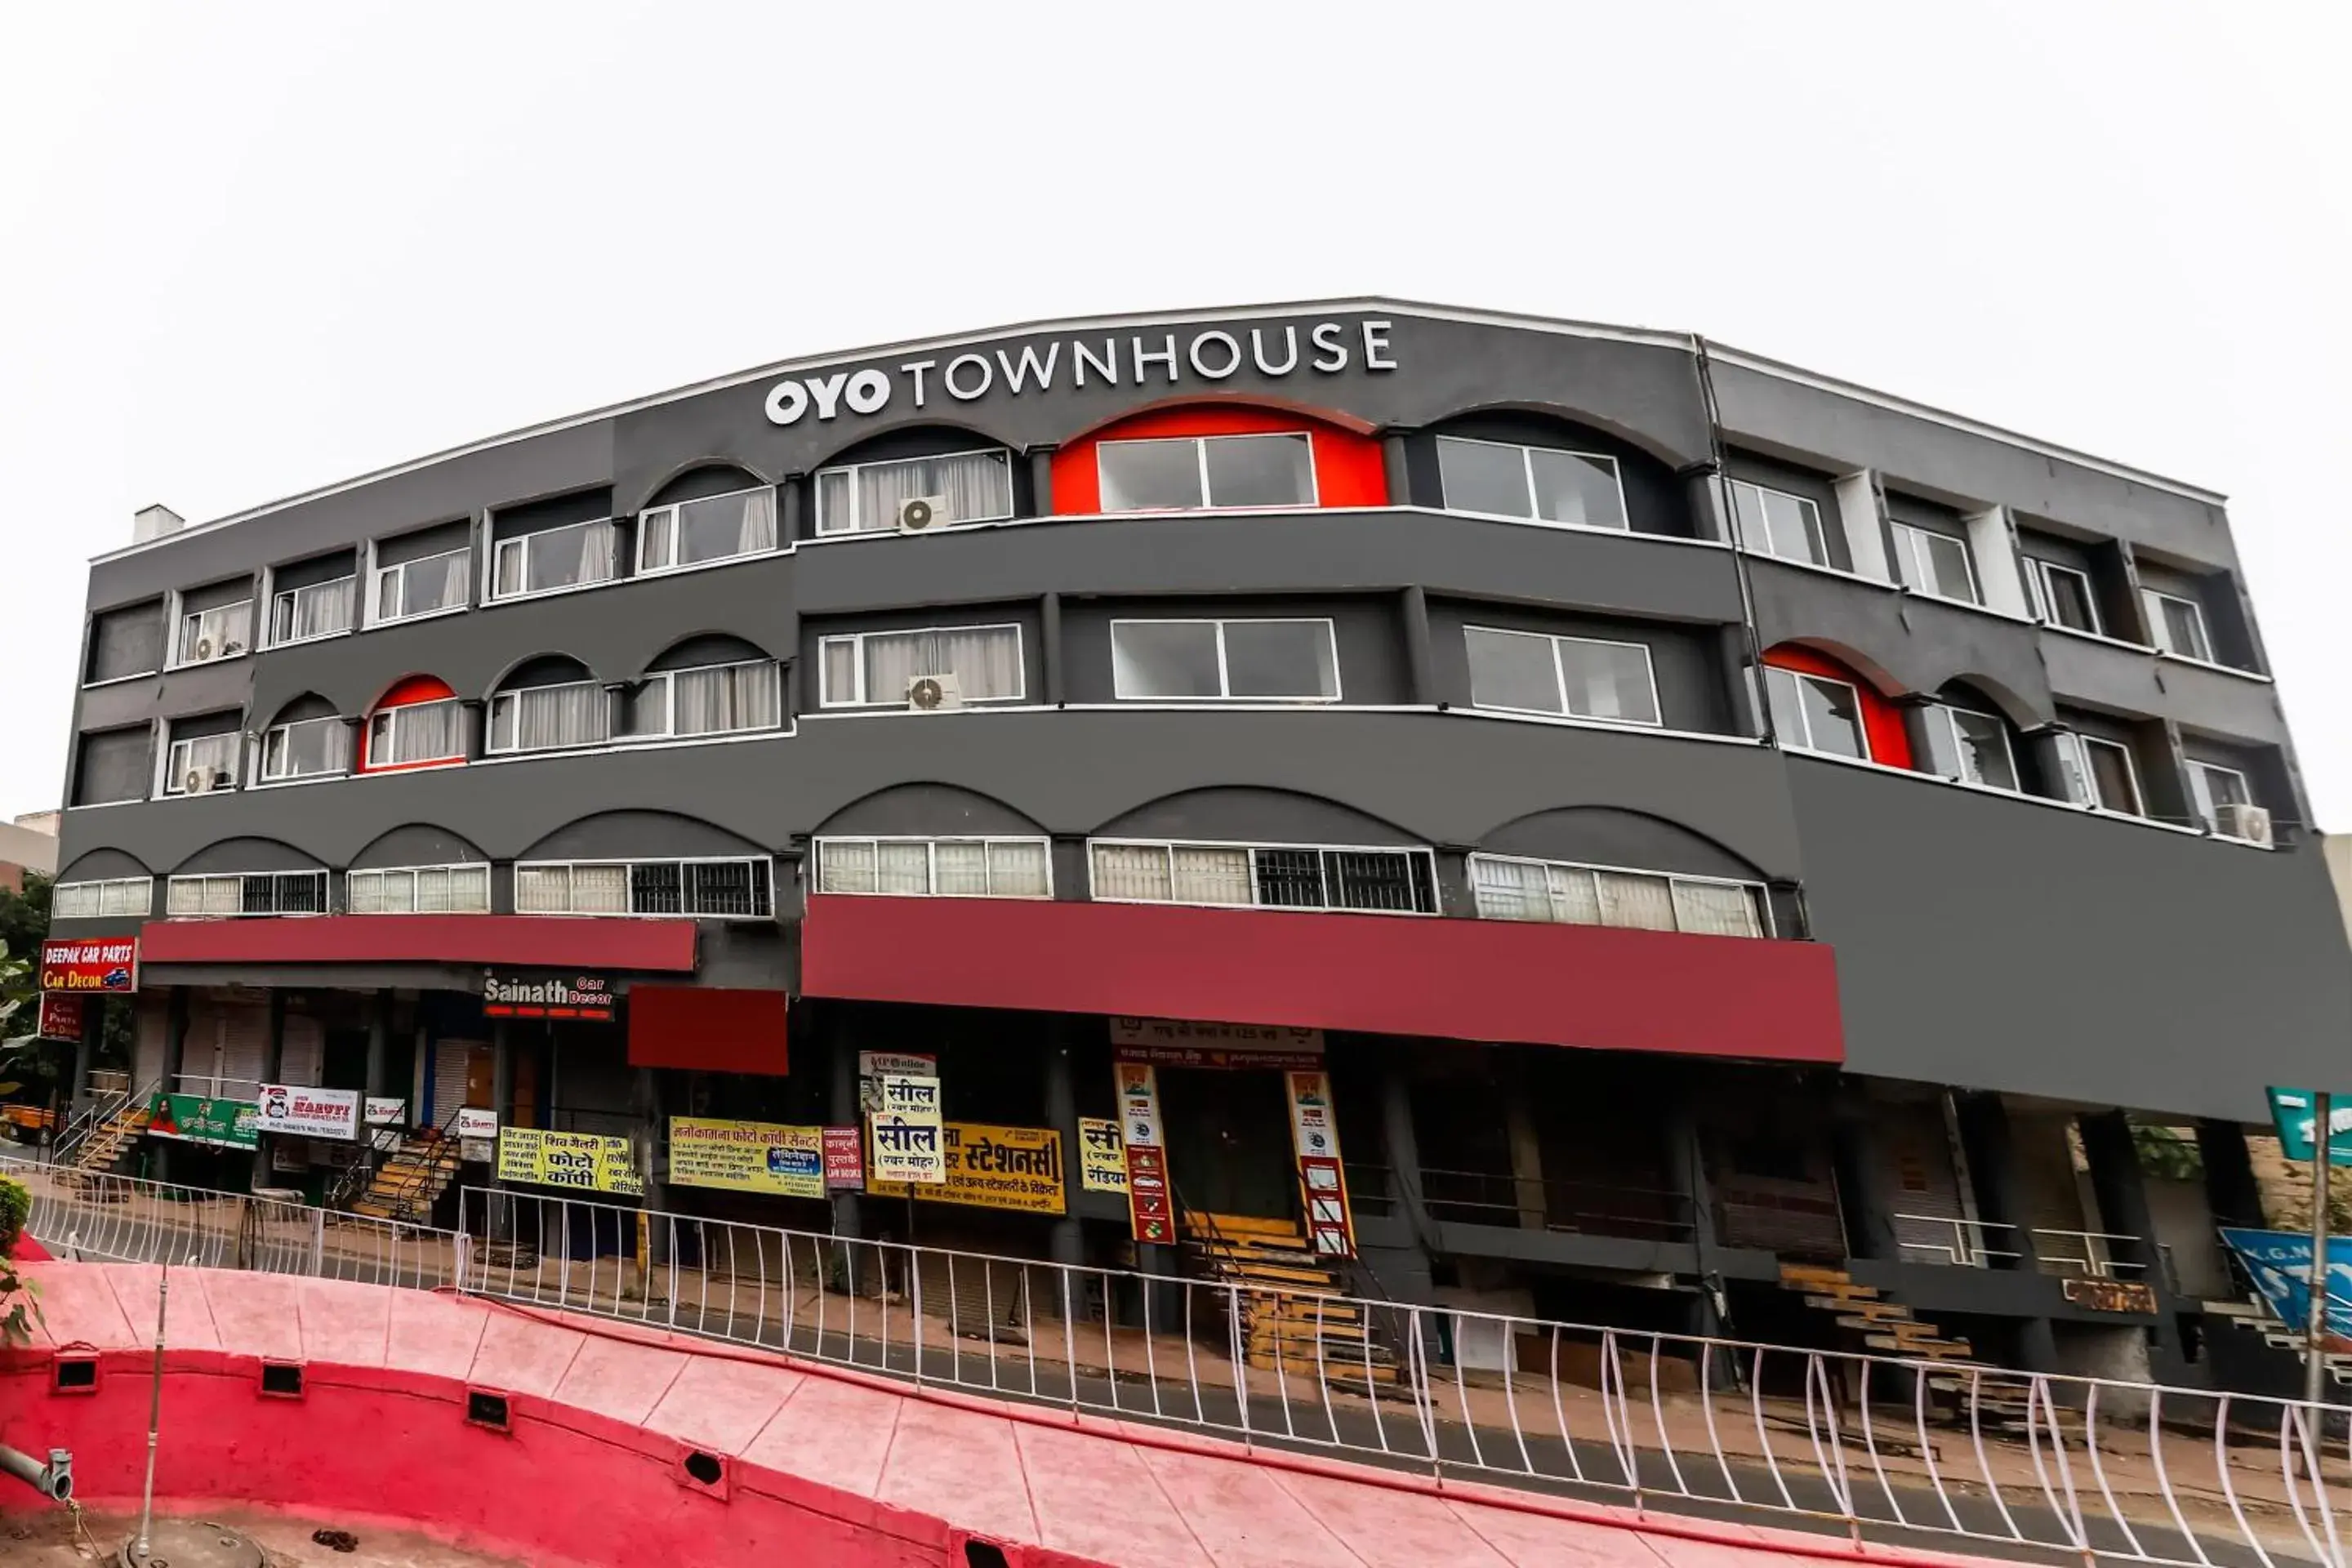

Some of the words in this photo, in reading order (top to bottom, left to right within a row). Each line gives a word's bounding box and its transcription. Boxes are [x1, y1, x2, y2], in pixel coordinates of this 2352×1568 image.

[764, 368, 891, 425] OYO
[901, 320, 1399, 407] TOWNHOUSE
[46, 947, 81, 964] DEEPAK
[82, 947, 100, 964] CAR
[101, 945, 132, 963] PARTS
[484, 978, 568, 1004] Sainath
[577, 976, 604, 991] Car
[568, 990, 612, 1005] Decor
[887, 1078, 936, 1103] सील
[733, 1127, 757, 1143] फोटो
[760, 1129, 786, 1146] कॉपी
[876, 1116, 938, 1152] सील
[1085, 1123, 1124, 1150] सी
[548, 1151, 595, 1169] फोटो
[546, 1169, 594, 1187] कॉपी
